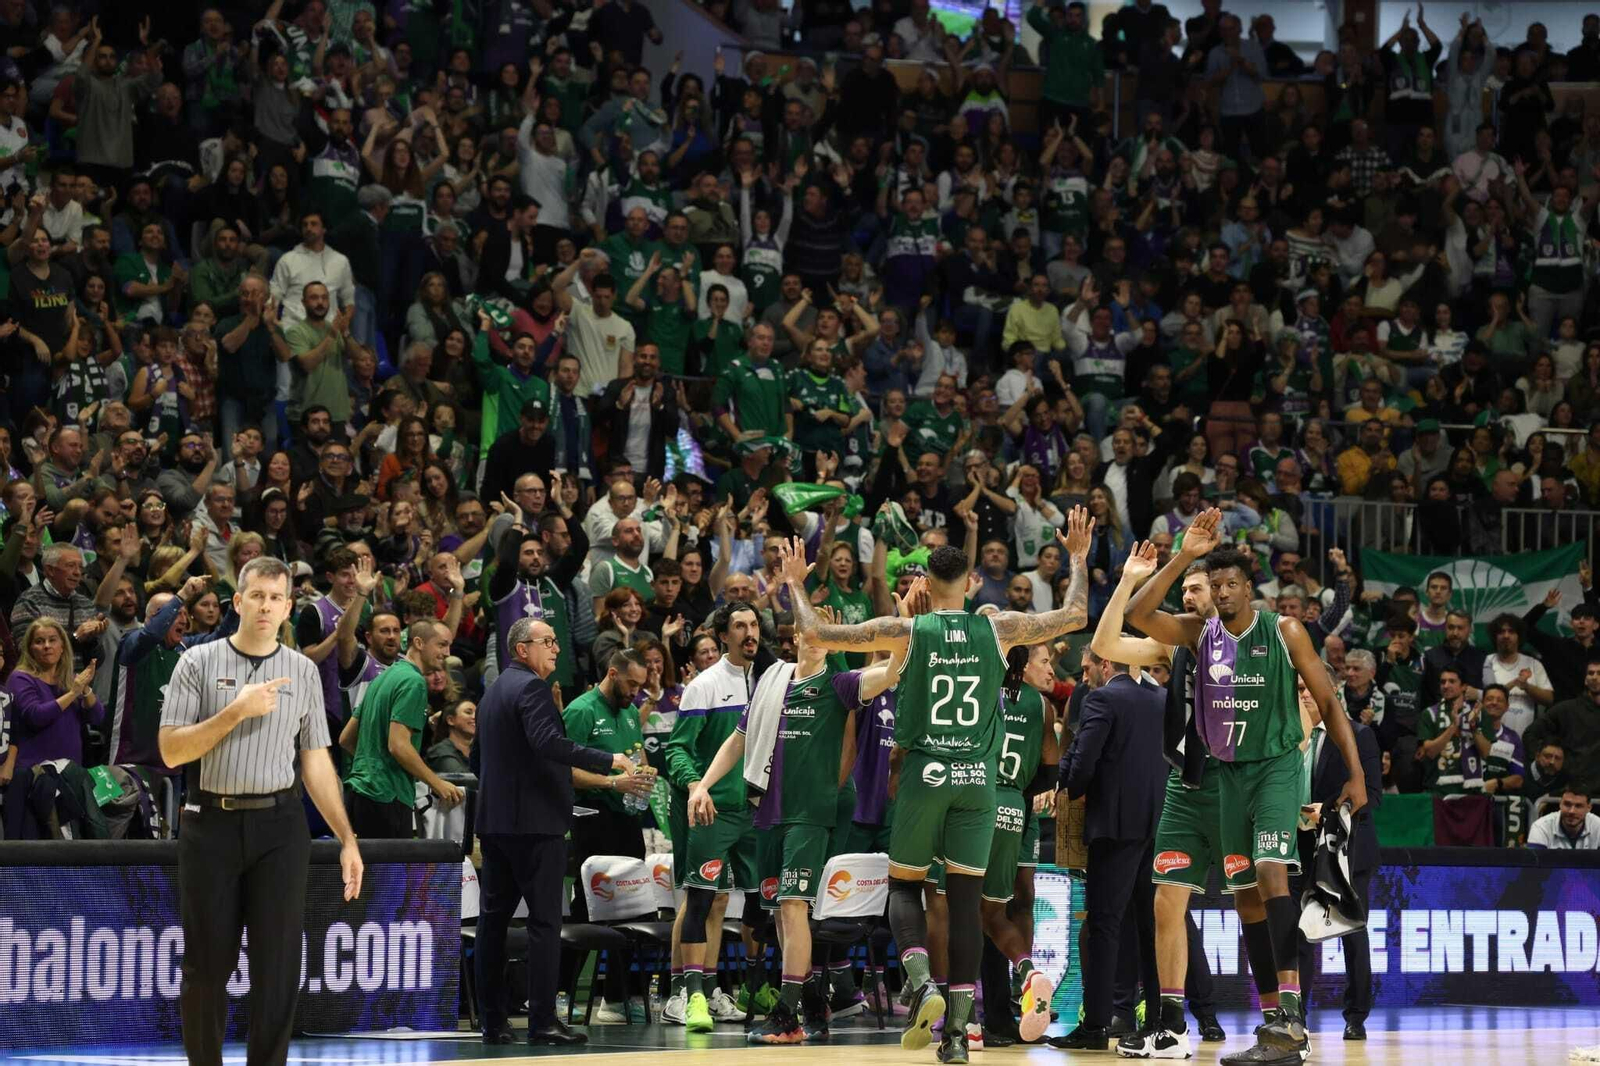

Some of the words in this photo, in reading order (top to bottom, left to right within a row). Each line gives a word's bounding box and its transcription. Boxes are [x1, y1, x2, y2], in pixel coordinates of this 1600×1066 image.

[945, 630, 967, 643] LIMA
[1230, 673, 1265, 684] Unicaja
[931, 675, 980, 726] 23
[783, 706, 815, 716] Unicaja
[1223, 721, 1247, 746] 77
[951, 762, 986, 770] COSTA
[951, 770, 968, 778] DEL
[970, 770, 986, 778] SOL
[951, 777, 986, 785] MÁLAGA
[997, 806, 1023, 817] COSTA
[996, 815, 1012, 823] DEL
[1400, 909, 1600, 972] ENTRAD
